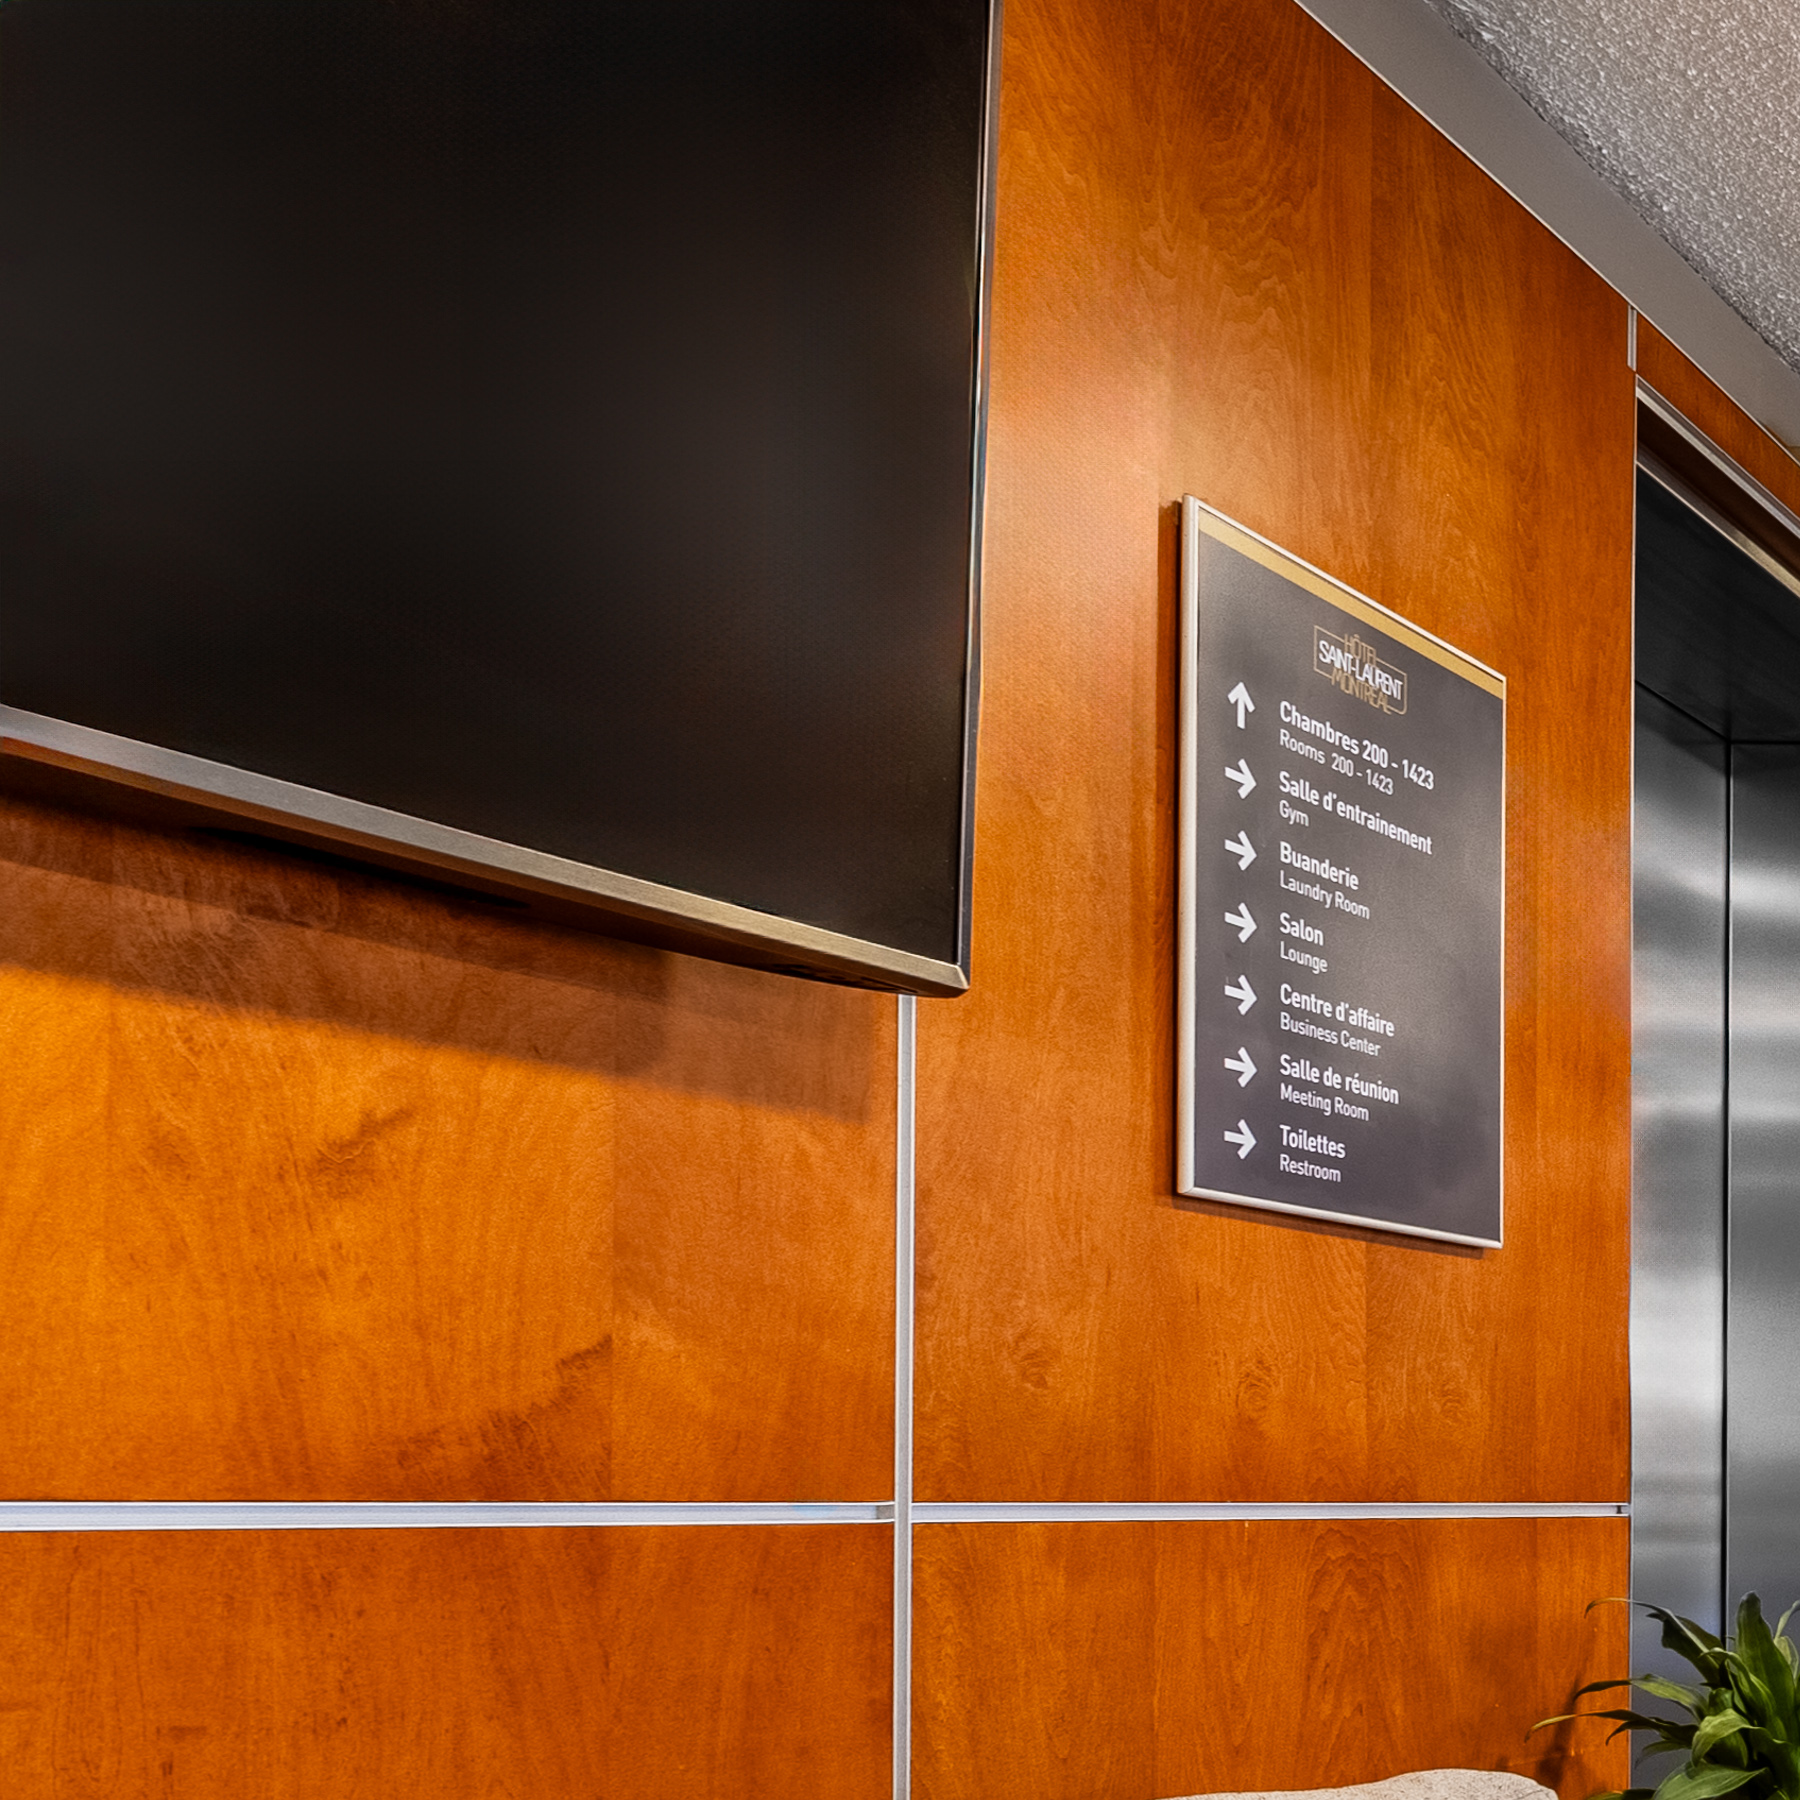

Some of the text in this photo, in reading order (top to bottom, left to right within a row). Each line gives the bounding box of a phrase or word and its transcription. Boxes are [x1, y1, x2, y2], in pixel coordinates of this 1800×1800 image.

[1319, 639, 1403, 701] SAINT-LAURENT
[1279, 700, 1360, 755] Chambres
[1362, 740, 1389, 768] 200
[1402, 759, 1435, 790] 1423
[1280, 728, 1326, 765] Rooms
[1331, 753, 1354, 777] 200
[1366, 769, 1394, 795] 1423
[1279, 770, 1433, 855] Salle d'entrainement
[1279, 800, 1309, 827] Gym
[1280, 841, 1359, 890] Buanderie
[1280, 869, 1370, 920] Laundry Room
[1279, 912, 1324, 946] Salon
[1280, 941, 1328, 974] Lounge
[1280, 983, 1395, 1037] Centre d'affaire
[1280, 1012, 1381, 1056] Business Center
[1280, 1053, 1399, 1104] Salle de réunion
[1280, 1082, 1370, 1121] Meeting Room
[1279, 1124, 1346, 1159] Toilettes
[1280, 1153, 1341, 1182] Restroom
